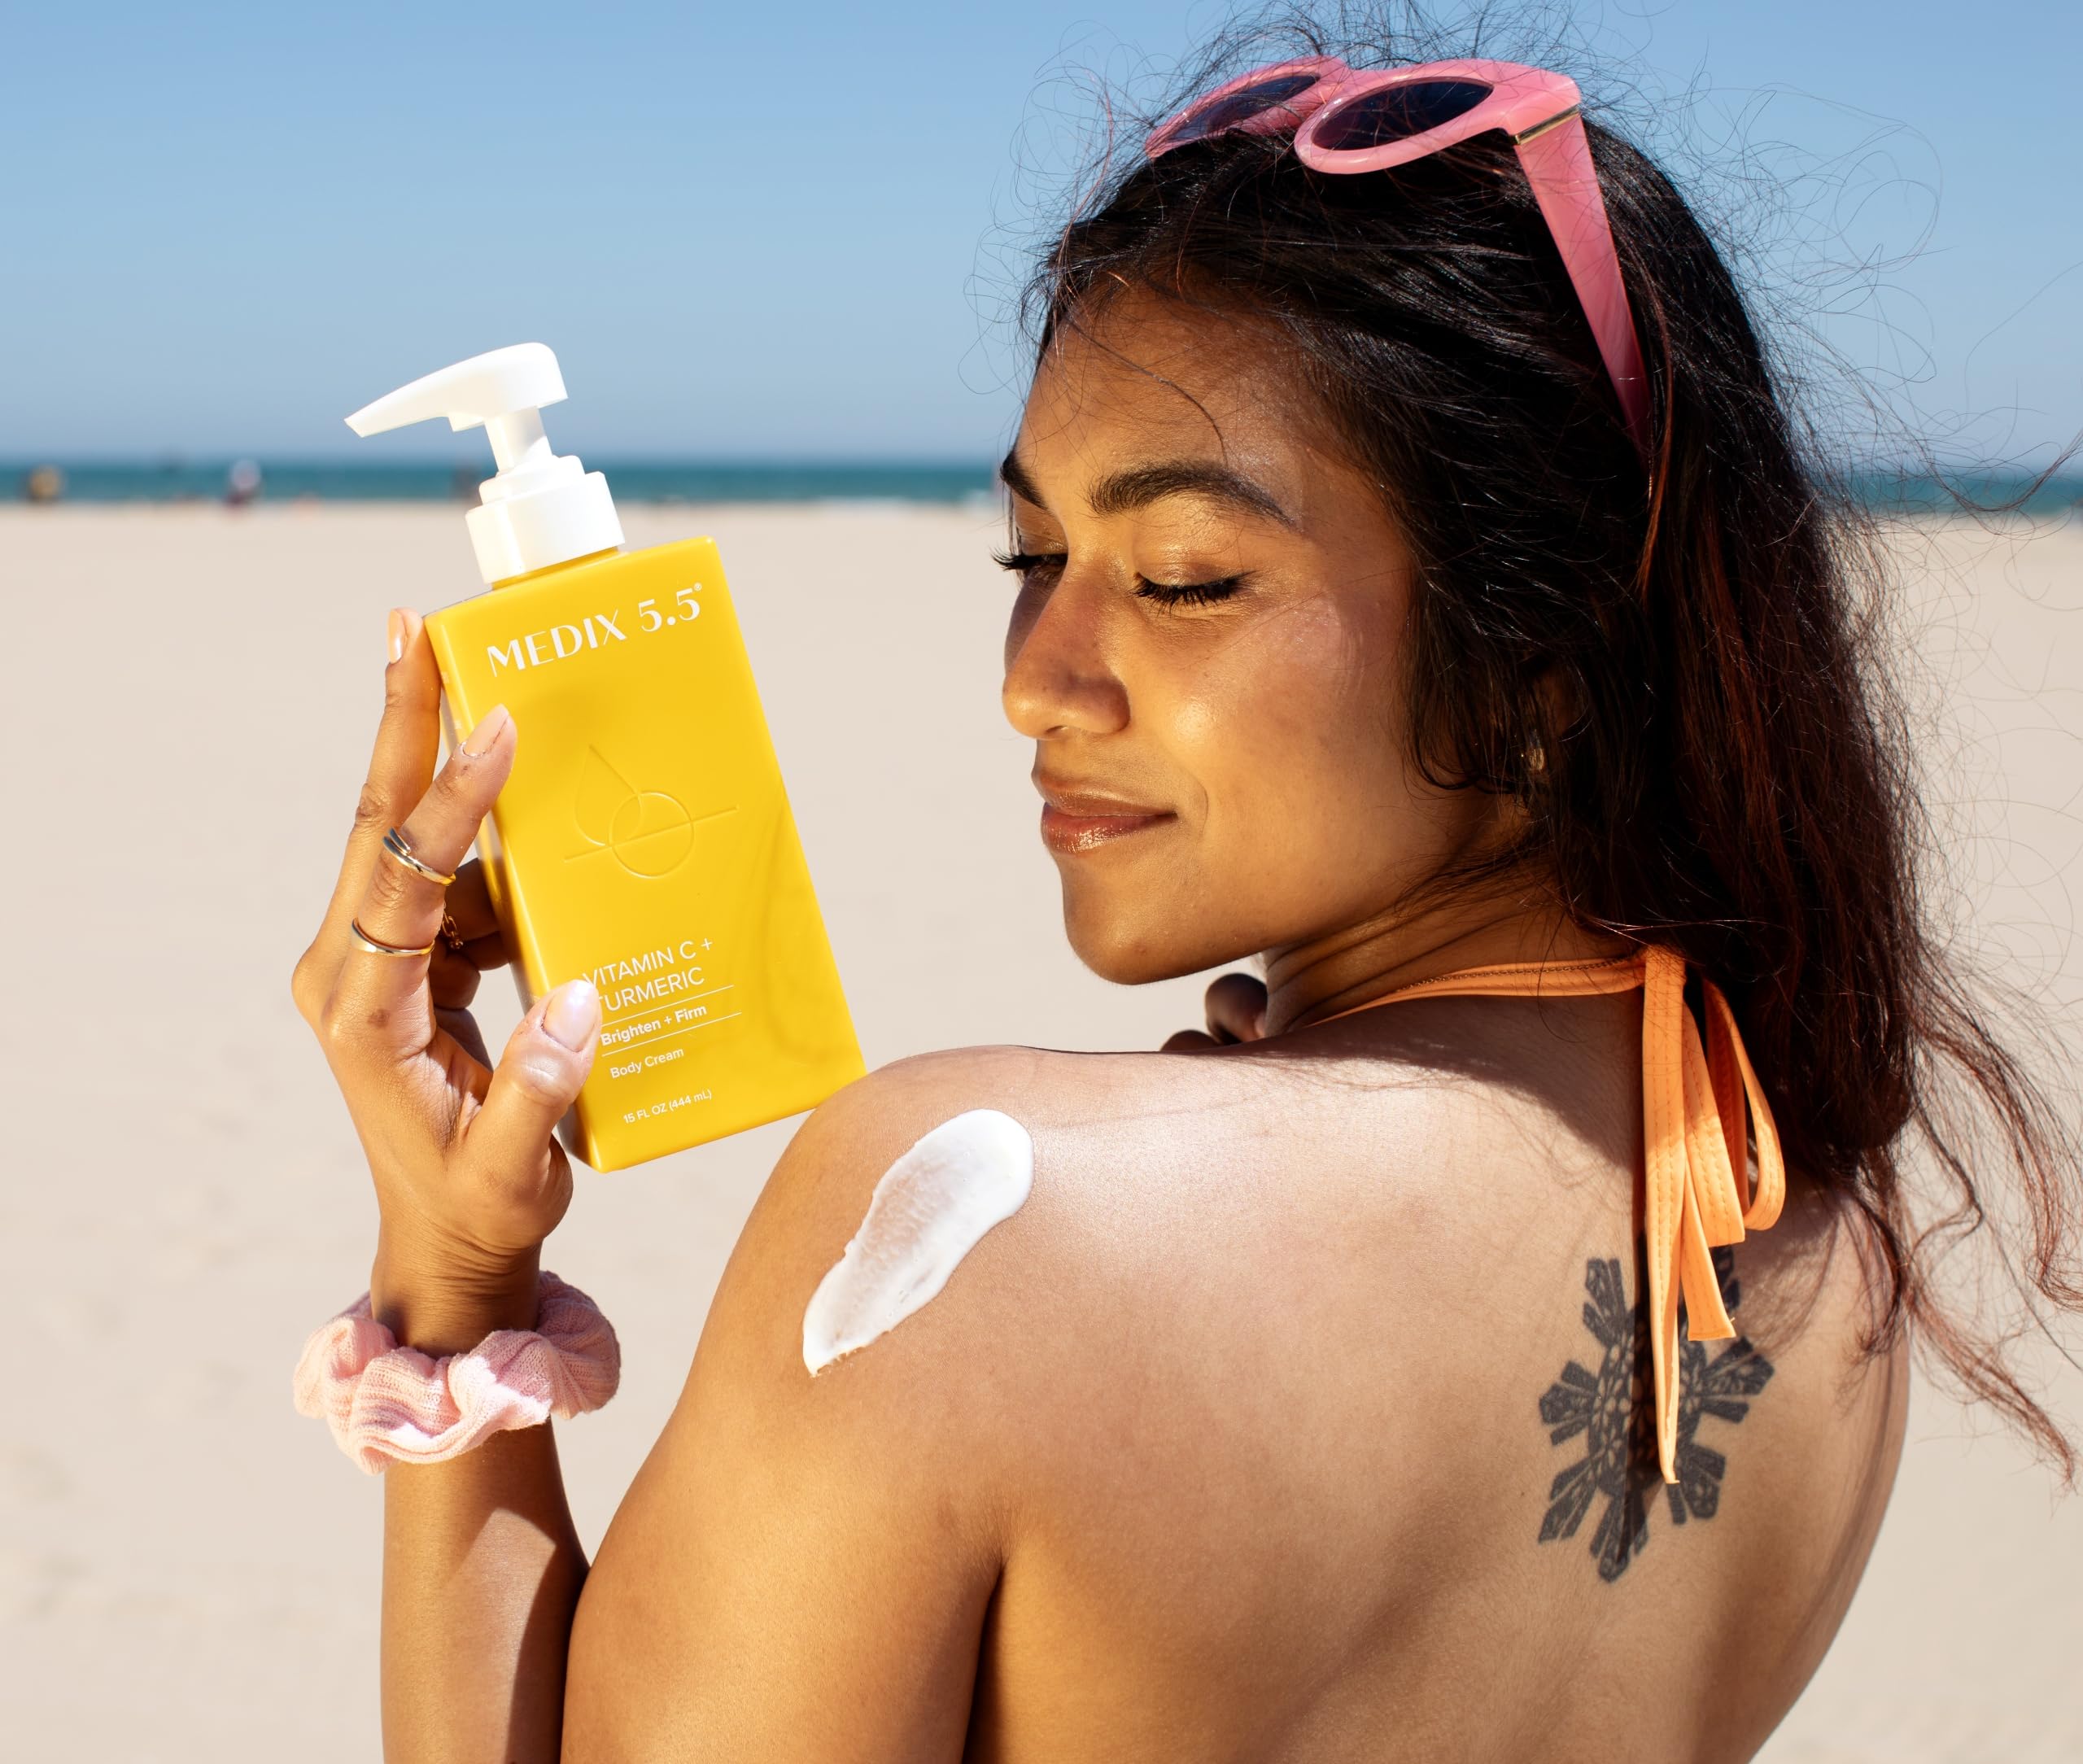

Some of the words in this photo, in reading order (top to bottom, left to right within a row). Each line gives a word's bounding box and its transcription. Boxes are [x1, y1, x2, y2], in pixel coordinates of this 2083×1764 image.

[487, 609, 627, 678] MEDIX
[582, 947, 674, 988] VITAMIN
[679, 941, 697, 959] C
[701, 938, 713, 950] +
[599, 967, 705, 1011] URMERIC
[600, 1019, 662, 1046] Brighten
[664, 1015, 672, 1025] +
[675, 1005, 706, 1023] Firm
[609, 1063, 643, 1079] Body
[644, 1047, 685, 1068] Cream
[623, 1112, 635, 1124] 15
[636, 1107, 650, 1120] FL
[651, 1102, 668, 1115] OZ
[669, 1094, 692, 1112] (444
[693, 1089, 713, 1102] mL)
